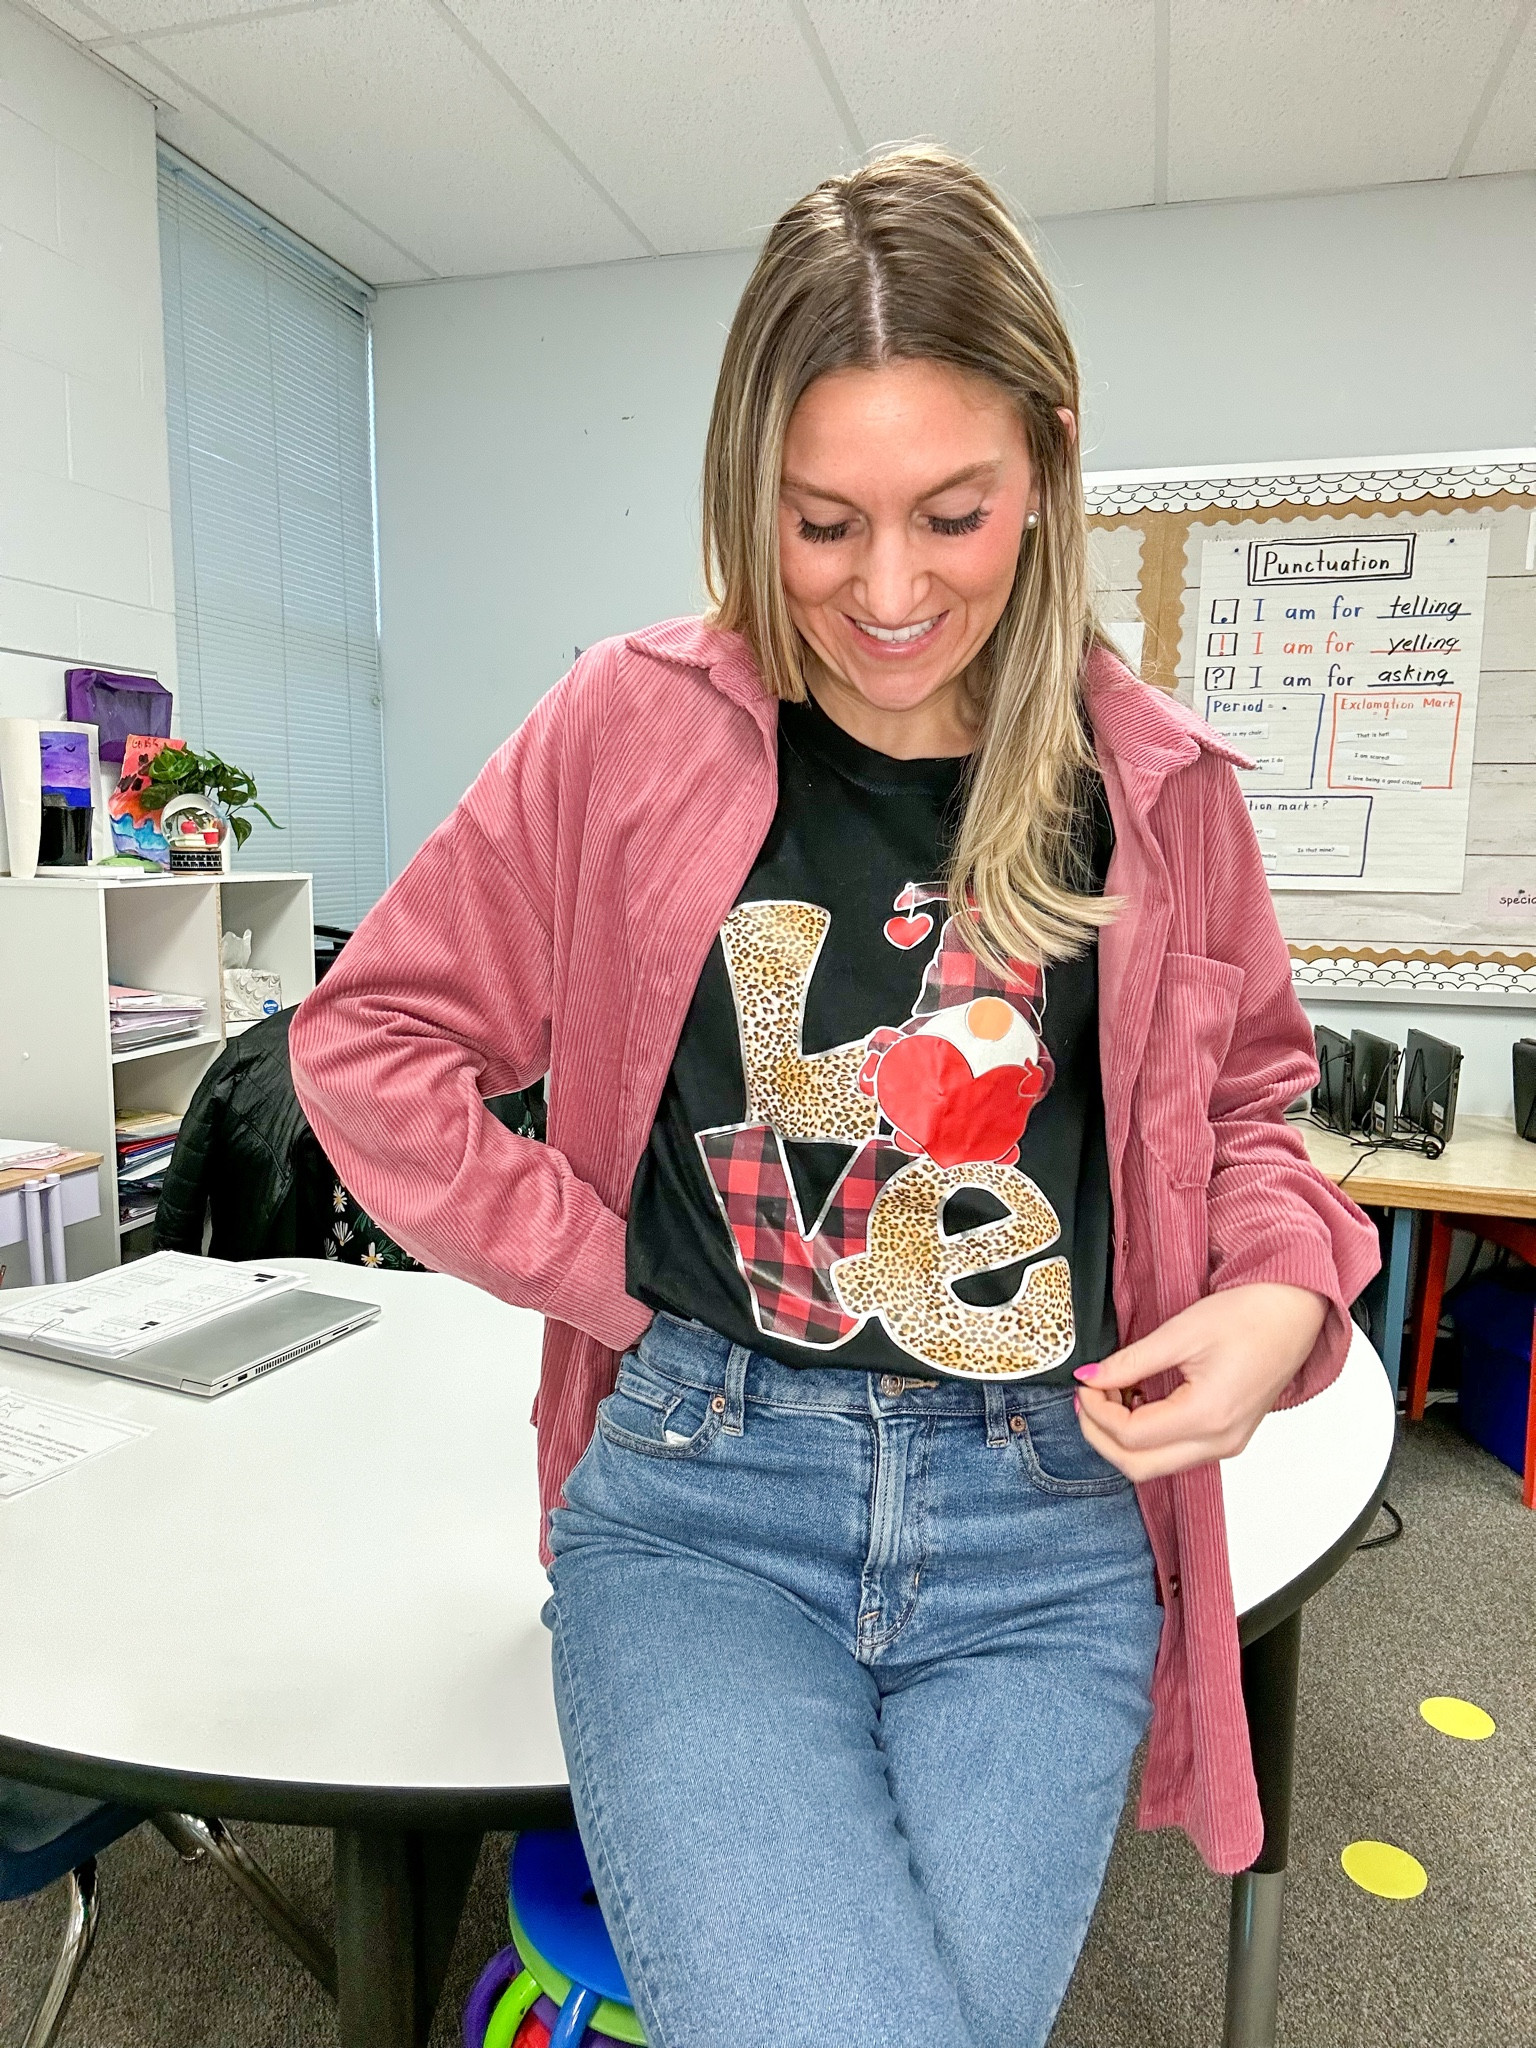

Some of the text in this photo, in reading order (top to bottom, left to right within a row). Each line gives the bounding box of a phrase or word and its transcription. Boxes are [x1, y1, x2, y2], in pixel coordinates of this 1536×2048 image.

[1263, 548, 1390, 577] Punctuation
[1253, 598, 1265, 622] I
[1285, 607, 1316, 620] am
[1332, 594, 1364, 620] for
[1390, 595, 1462, 622] telling
[1251, 632, 1264, 655] I
[1283, 641, 1313, 654] am
[1325, 630, 1355, 654] for
[1388, 633, 1460, 656] yelling
[1249, 666, 1263, 689] I
[1283, 675, 1312, 687] am
[1328, 663, 1356, 688] for
[1378, 664, 1449, 687] asking
[1213, 698, 1264, 713] Period
[1340, 697, 1456, 710] Exclamation Mark
[1365, 776, 1380, 784] being
[1249, 800, 1272, 811] tion
[1278, 800, 1310, 811] mark
